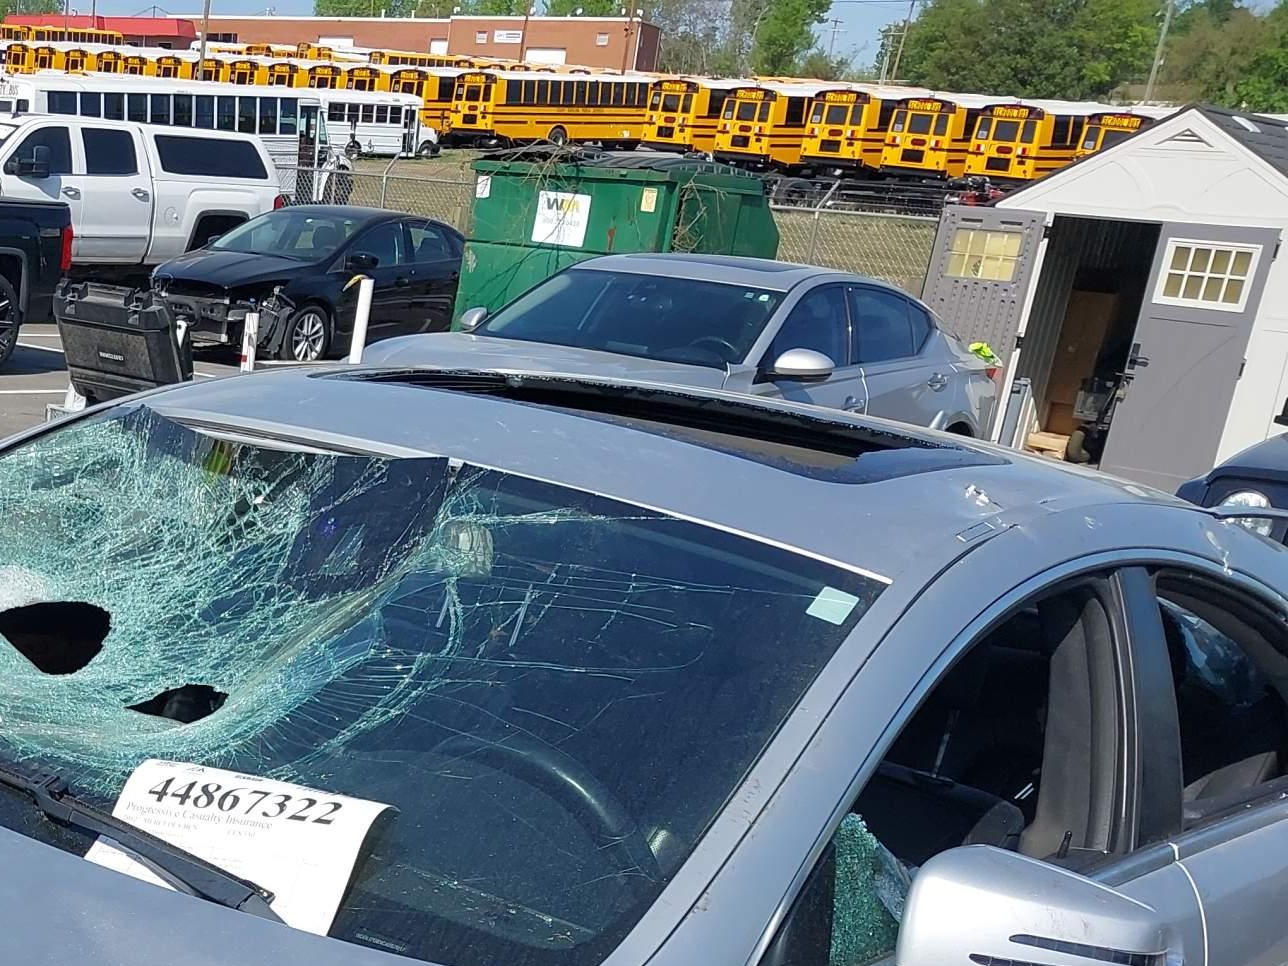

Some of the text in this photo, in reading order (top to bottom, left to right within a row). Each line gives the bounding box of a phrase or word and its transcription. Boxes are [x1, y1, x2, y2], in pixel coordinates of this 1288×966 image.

[125, 801, 179, 818] Progressive
[182, 810, 221, 824] Casualty
[225, 815, 273, 830] Insurance
[148, 776, 343, 825] 44867322
